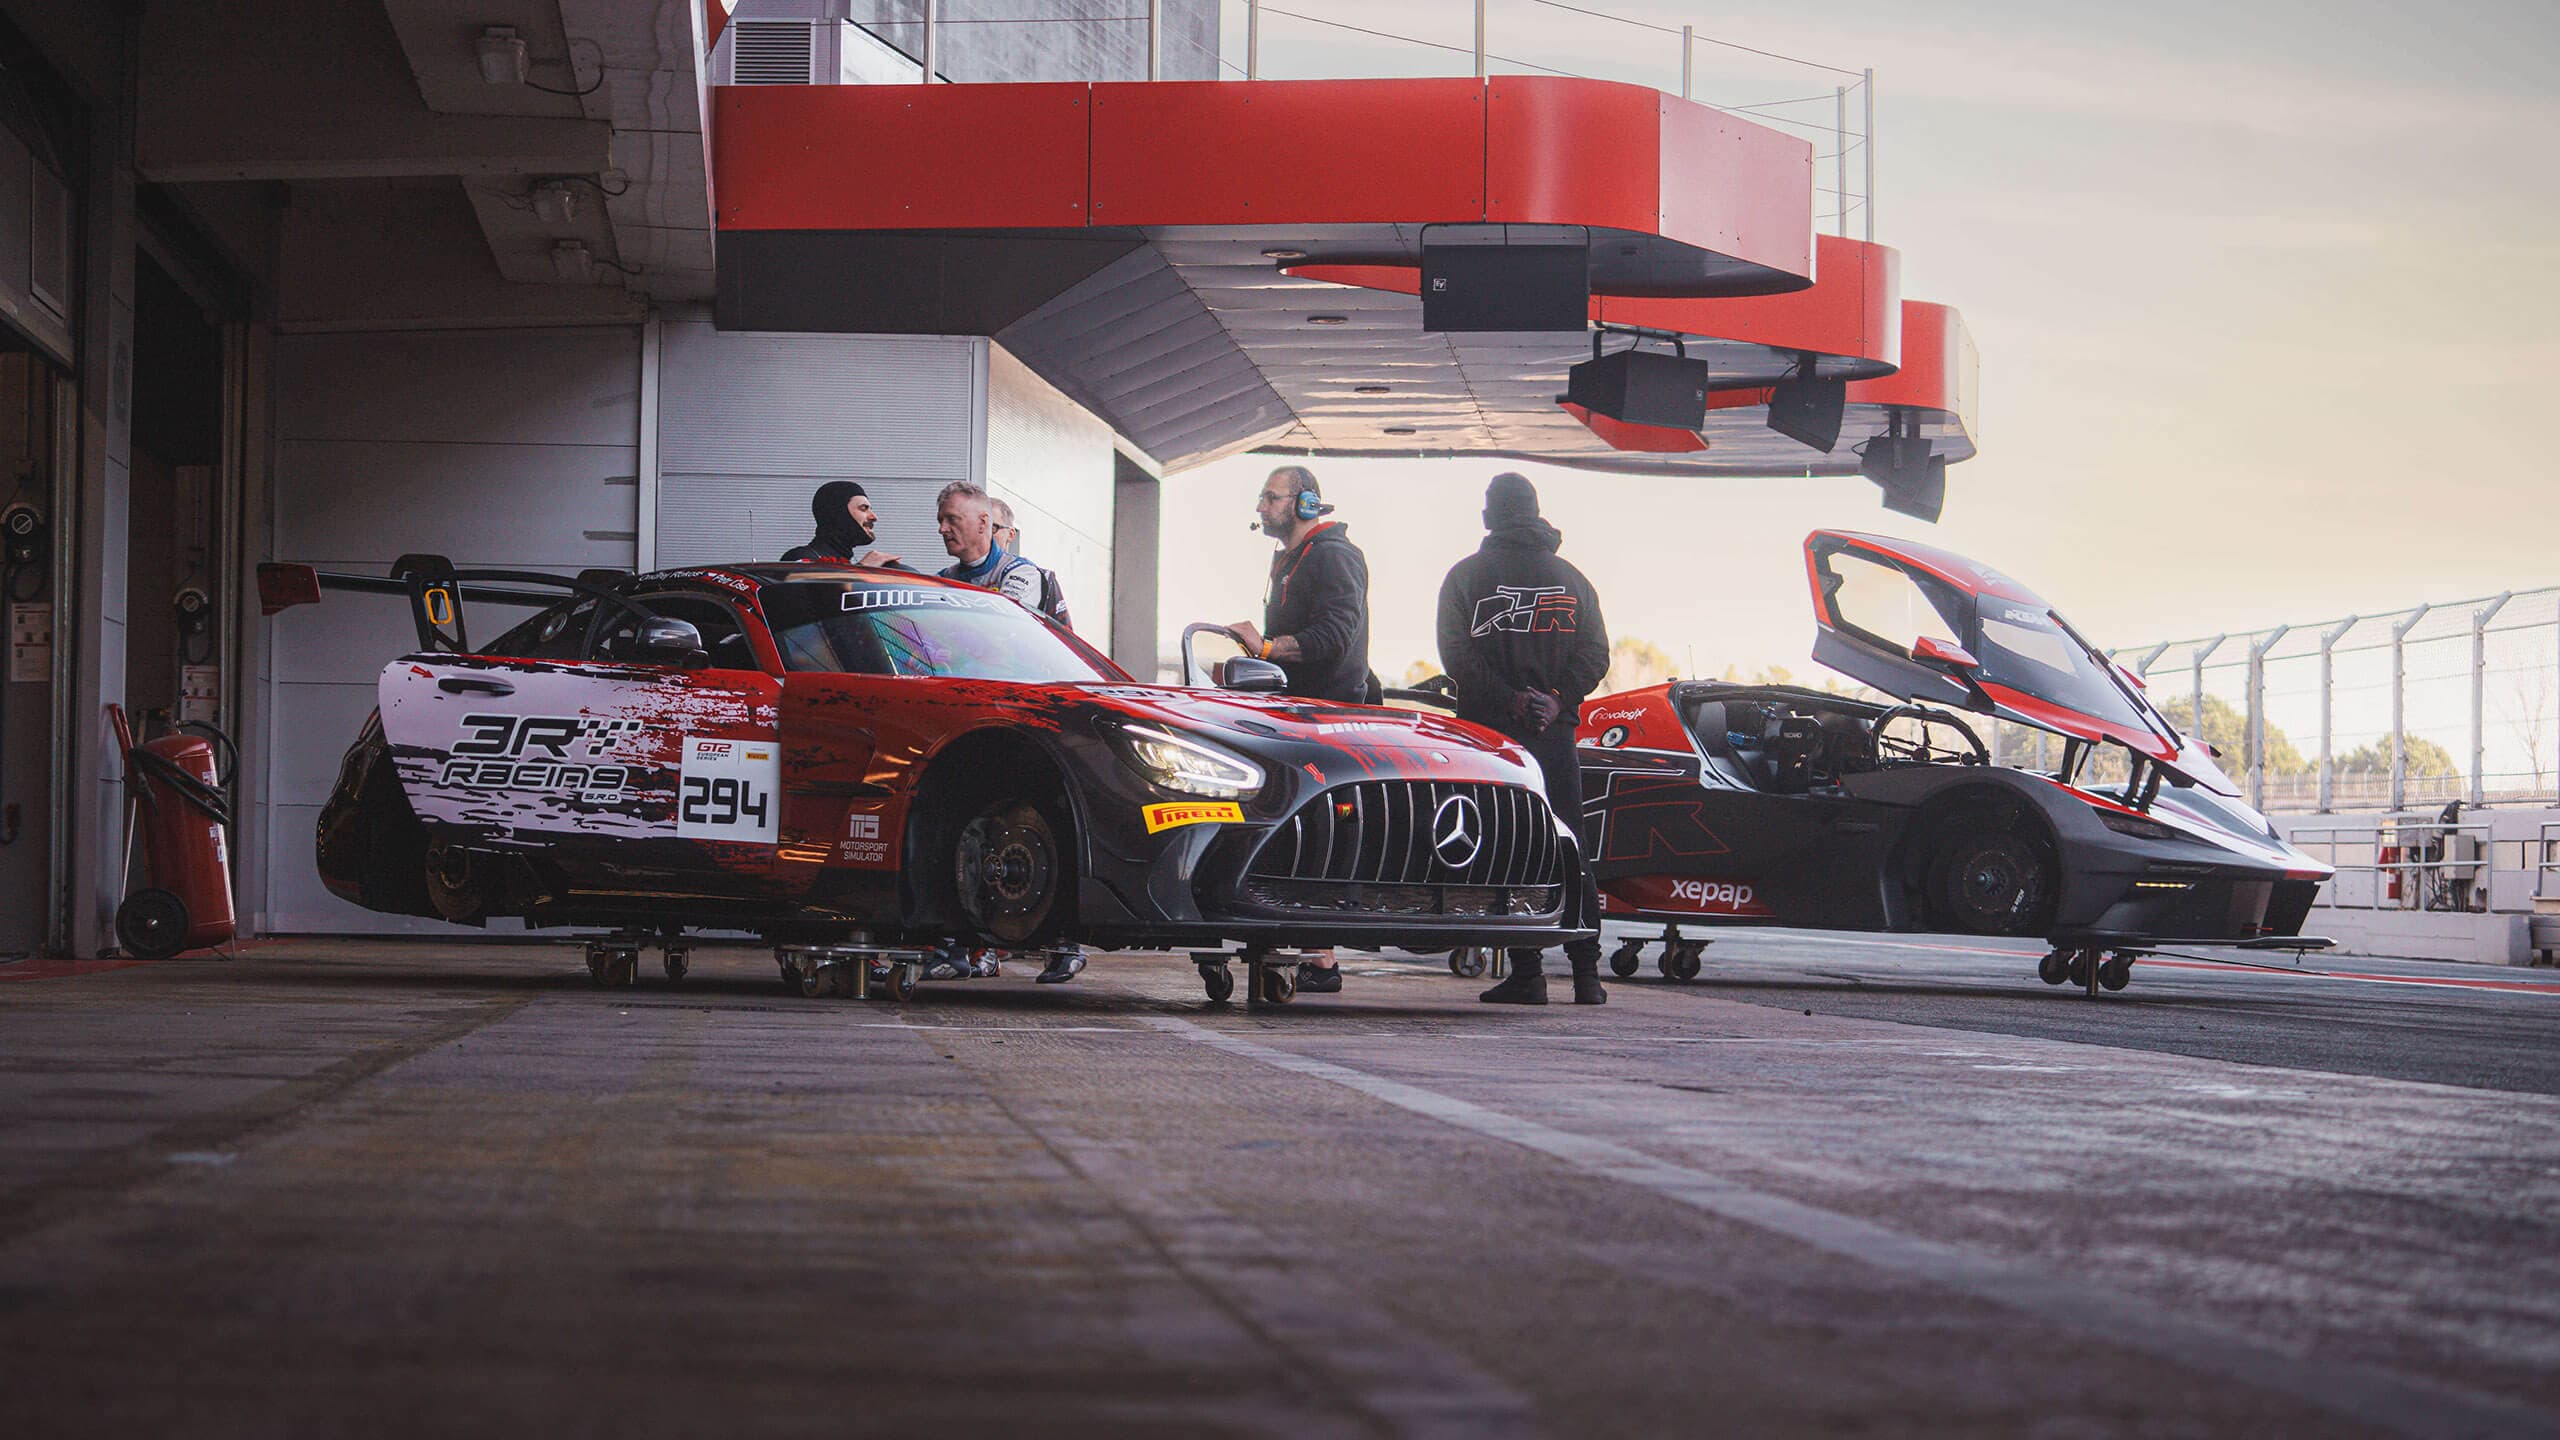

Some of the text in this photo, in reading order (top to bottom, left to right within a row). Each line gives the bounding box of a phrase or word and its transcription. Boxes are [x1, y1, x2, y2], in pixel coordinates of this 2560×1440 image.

[697, 742, 732, 753] GT2
[683, 776, 768, 828] 294
[1153, 806, 1234, 826] PIRELLI
[840, 841, 889, 852] MOTORSPORT
[844, 851, 884, 862] SIMULATOR
[1670, 879, 1753, 911] xepap
